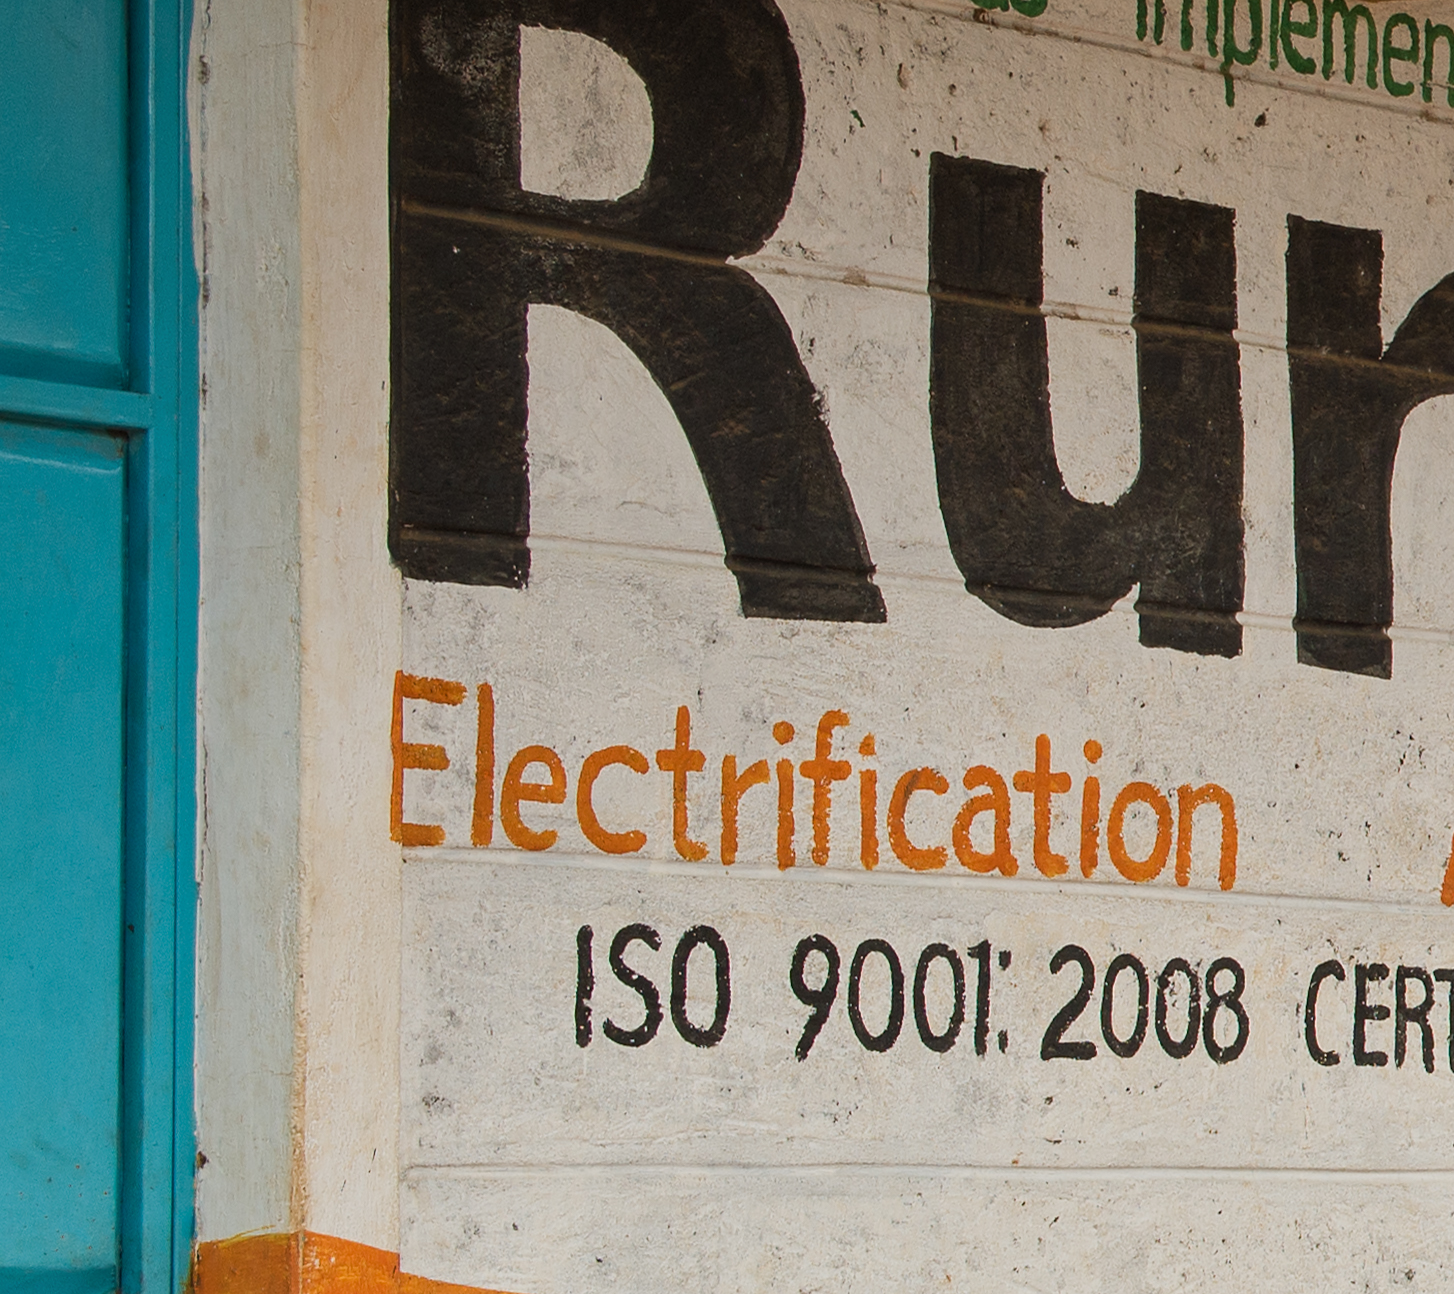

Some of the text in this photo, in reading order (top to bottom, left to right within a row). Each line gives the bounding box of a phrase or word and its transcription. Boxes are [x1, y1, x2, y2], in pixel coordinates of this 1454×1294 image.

[389, 670, 1240, 892] Electrification
[574, 922, 732, 1050] ISO
[1039, 944, 1251, 1066] 2008
